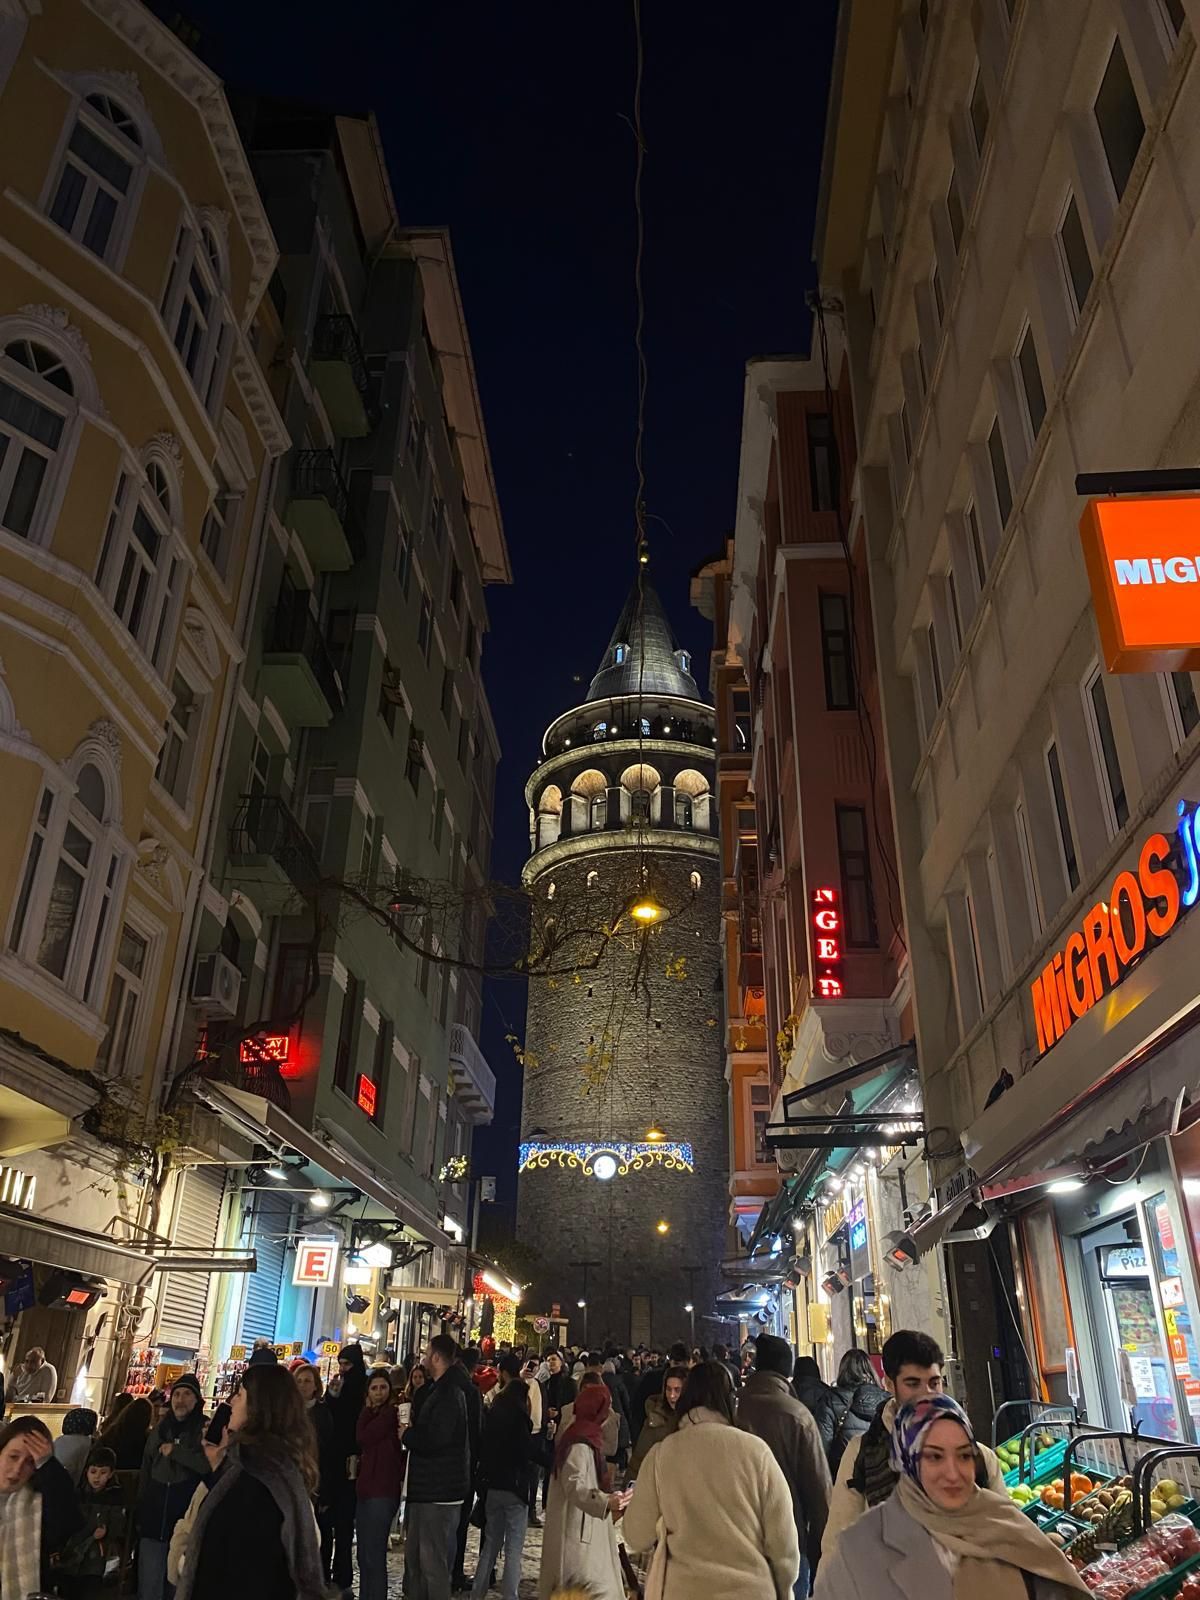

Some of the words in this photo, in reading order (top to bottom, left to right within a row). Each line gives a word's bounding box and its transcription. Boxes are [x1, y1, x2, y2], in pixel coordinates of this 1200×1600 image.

[1114, 556, 1200, 586] MiG
[304, 1252, 326, 1277] E
[325, 1344, 338, 1354] 50
